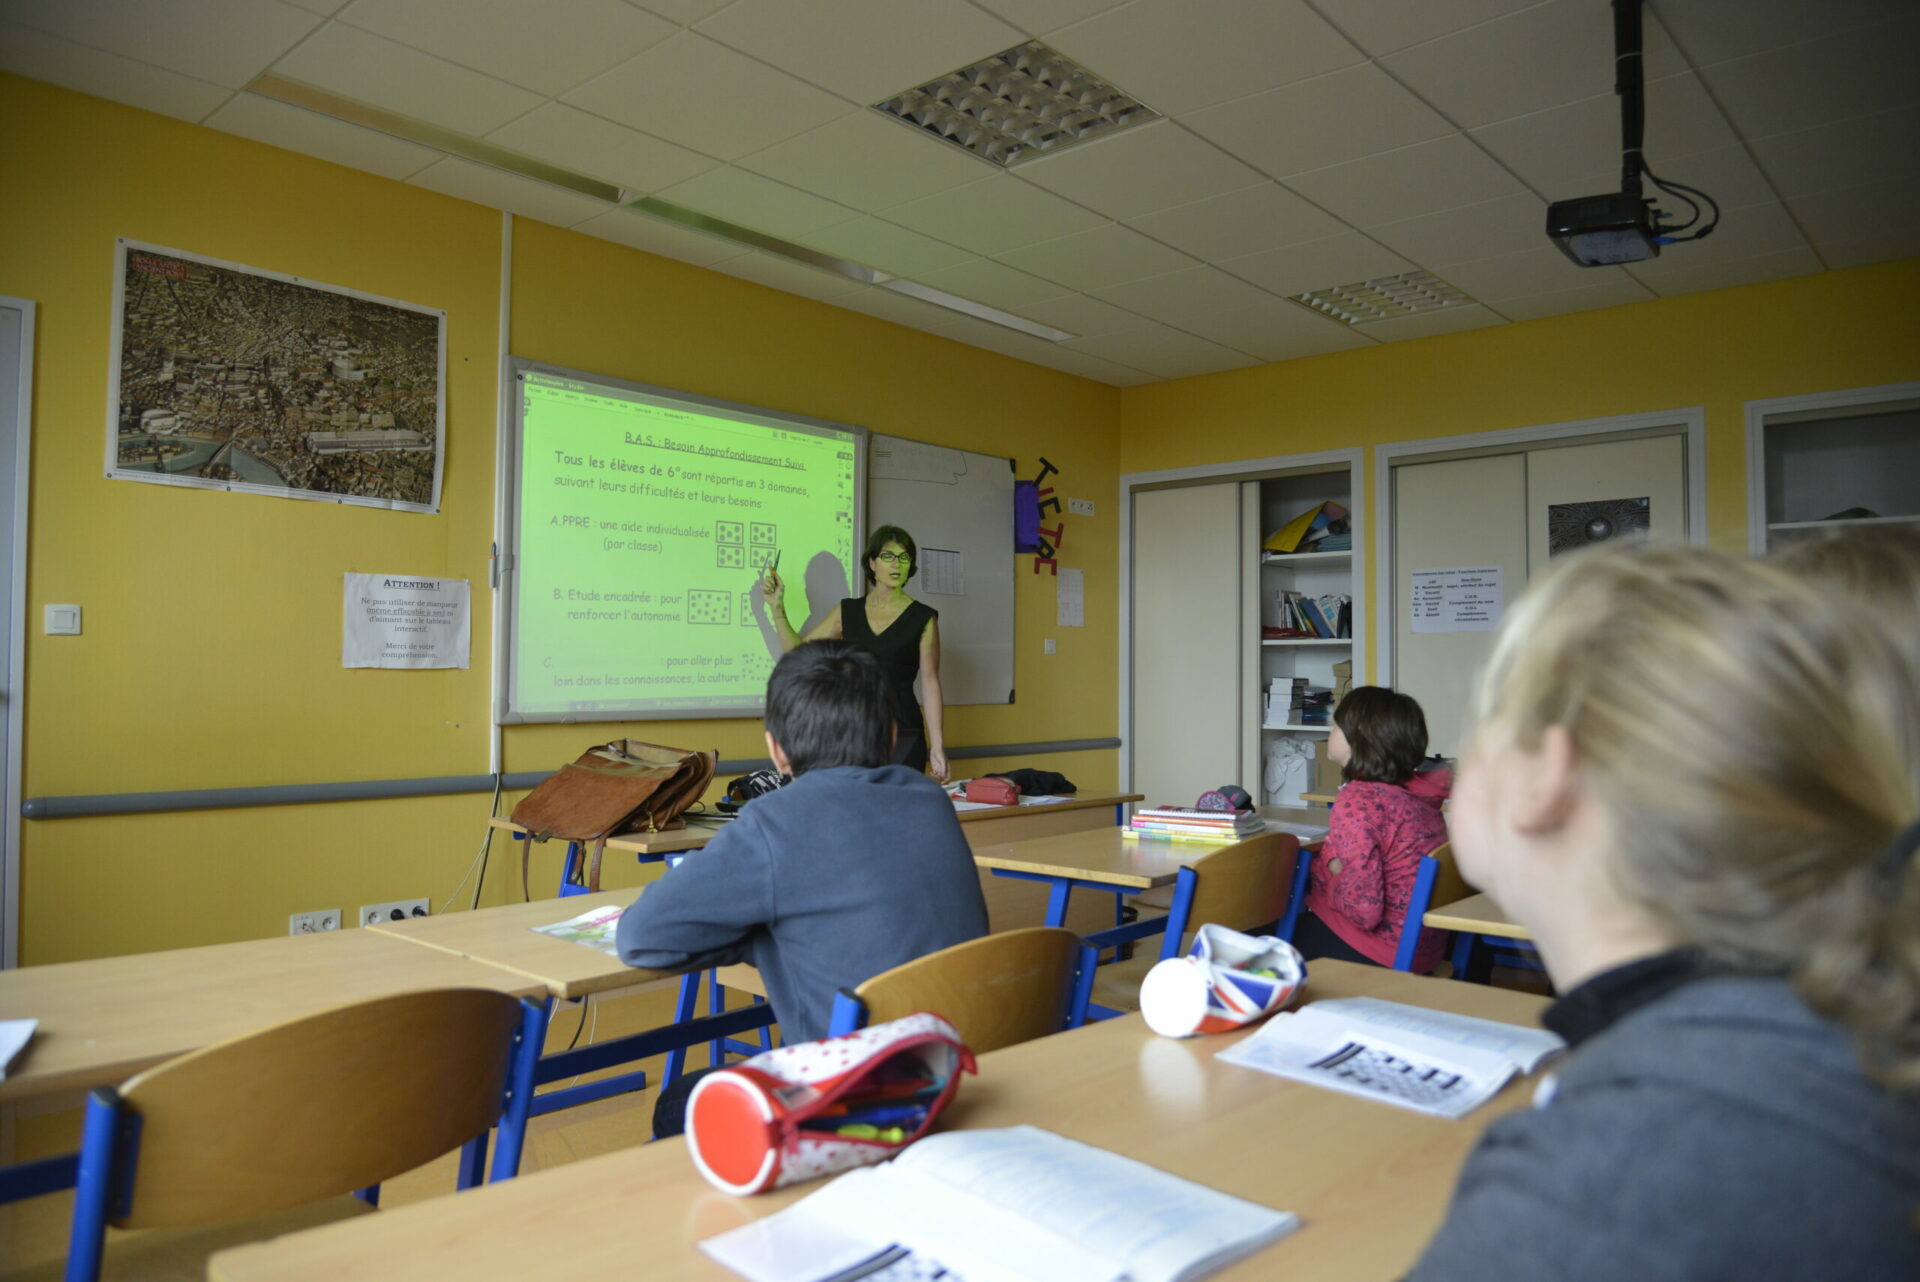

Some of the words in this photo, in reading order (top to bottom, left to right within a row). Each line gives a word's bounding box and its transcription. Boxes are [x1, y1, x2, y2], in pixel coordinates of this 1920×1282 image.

[664, 438, 695, 453] Besoin
[697, 444, 782, 466] Approfondissement
[554, 450, 584, 466] Tous
[589, 455, 606, 469] les
[610, 458, 646, 474] élèves
[650, 464, 663, 476] de
[681, 471, 702, 481] sont
[705, 472, 745, 487] répartis
[745, 479, 757, 488] en
[760, 479, 766, 490] 3
[553, 475, 596, 489] suivant
[600, 477, 627, 493] leurs
[629, 482, 686, 500] difficultés
[687, 490, 699, 501] et
[702, 490, 726, 505] leurs
[728, 494, 762, 508] besoins
[600, 521, 618, 530] une
[621, 520, 643, 532] aide
[646, 522, 711, 538] individualisée
[603, 537, 625, 551] (par
[627, 539, 662, 554] classe)
[384, 578, 435, 590] ATTENTION
[361, 597, 371, 605] Ne
[417, 599, 425, 607] de
[568, 588, 601, 601] Etude
[603, 591, 651, 603] encadrée
[660, 594, 682, 608] pour
[568, 608, 622, 621] renforcer
[624, 609, 681, 622] l'autonomie
[386, 642, 408, 650] Merci
[409, 642, 417, 650] de
[666, 655, 689, 670] pour
[690, 655, 713, 666] aller
[714, 655, 733, 669] plus
[553, 674, 574, 687] loin
[576, 673, 601, 687] dans
[604, 673, 620, 686] les
[697, 671, 706, 683] la
[707, 671, 740, 683] culture
